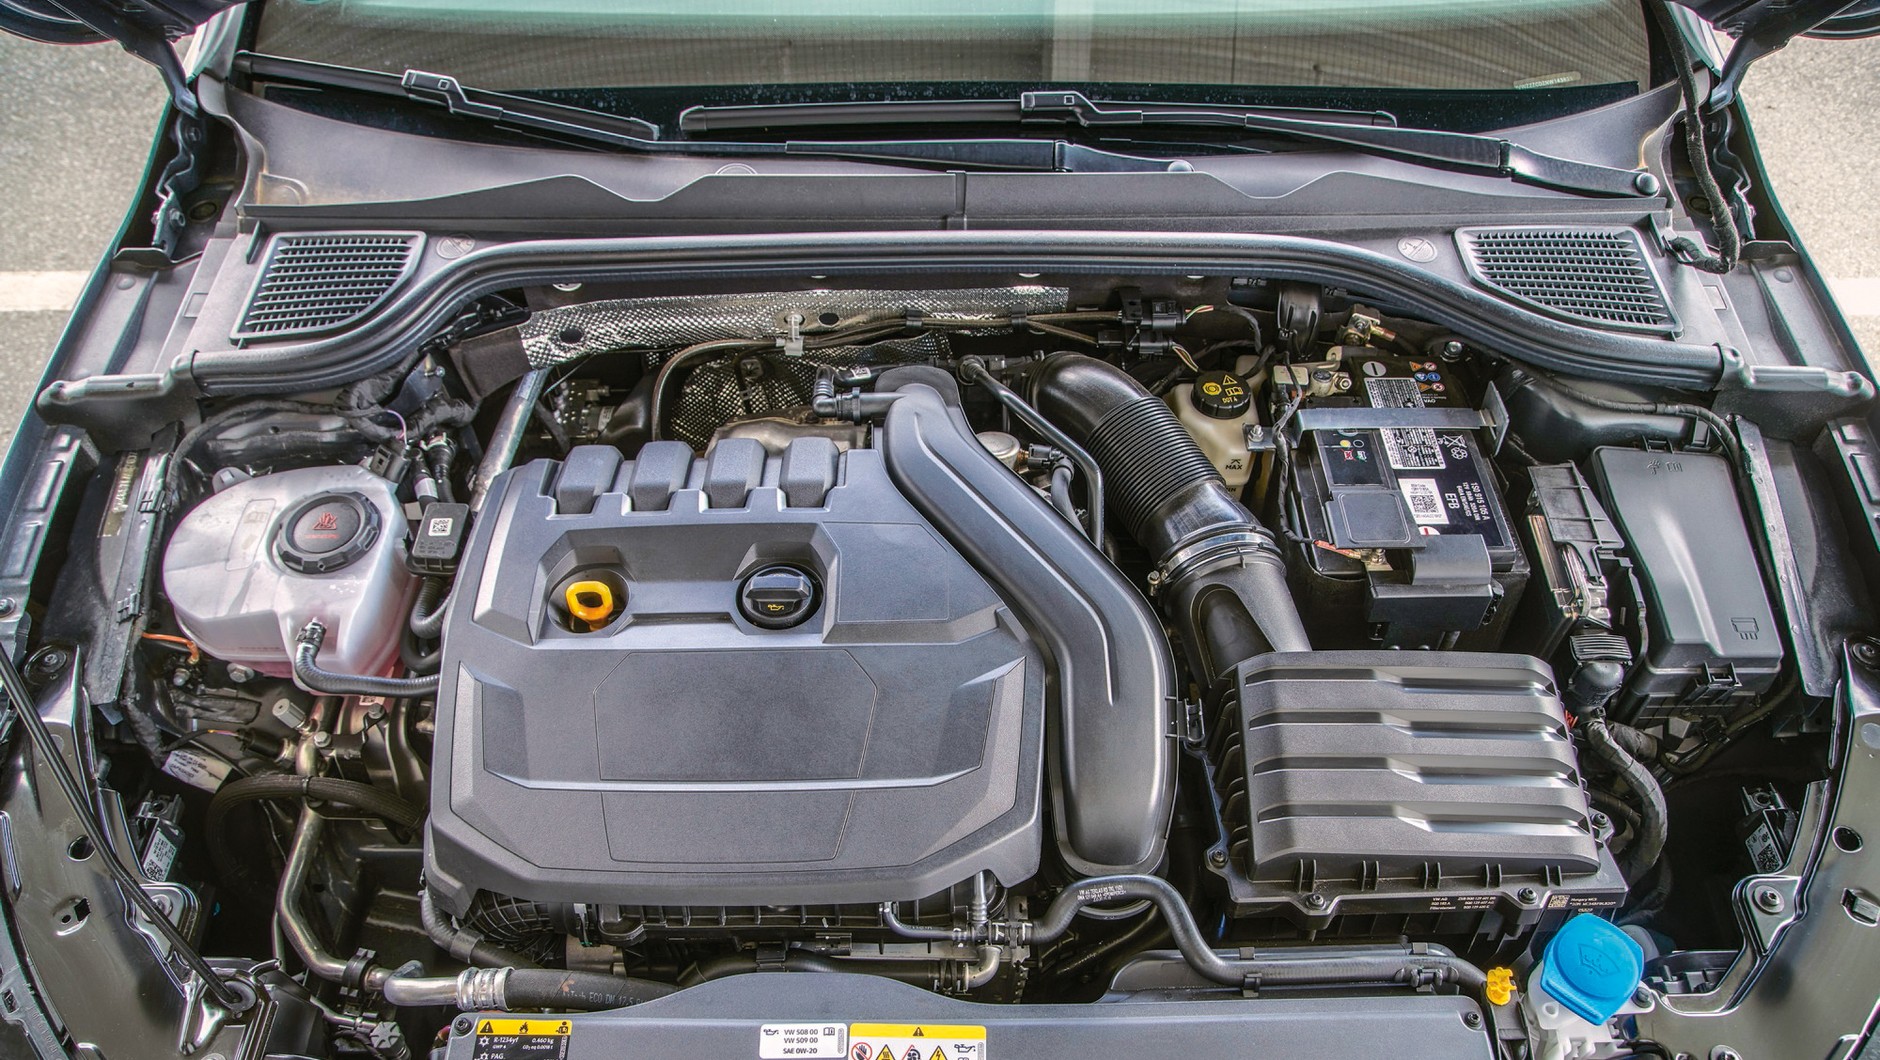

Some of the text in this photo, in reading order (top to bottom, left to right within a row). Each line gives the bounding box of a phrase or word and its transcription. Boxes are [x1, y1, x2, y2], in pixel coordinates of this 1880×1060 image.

[1444, 492, 1460, 509] EFB
[1474, 493, 1486, 504] 915
[589, 992, 602, 1003] ECO
[493, 1037, 519, 1045] R-1234yf
